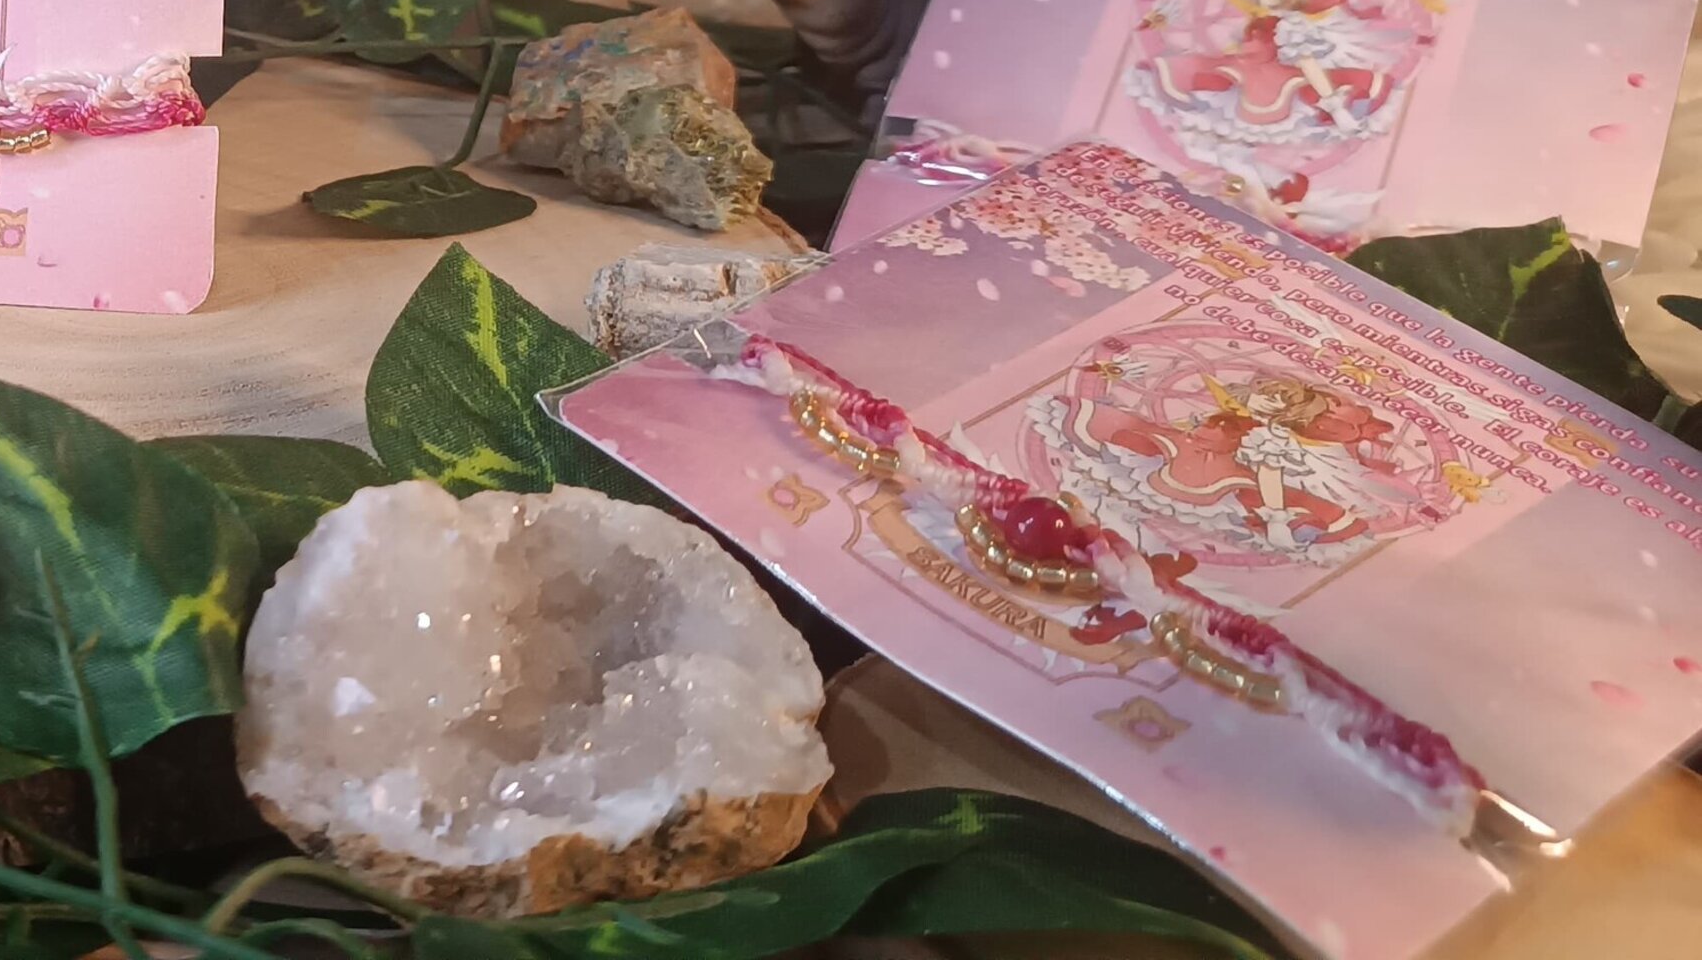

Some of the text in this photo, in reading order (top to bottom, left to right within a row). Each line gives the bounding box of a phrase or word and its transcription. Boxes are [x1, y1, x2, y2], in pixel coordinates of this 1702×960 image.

[1055, 166, 1085, 184] de
[1086, 183, 1169, 228] seguir
[1169, 225, 1282, 292] viviendo,
[1283, 288, 1353, 325] pero
[1352, 323, 1487, 395] mientras
[1486, 393, 1569, 438] sigas
[1079, 149, 1700, 480] En ocasiones es posible que la gente pierda su
[1132, 237, 1257, 302] cualquier
[1255, 301, 1320, 338] cosa
[1321, 336, 1355, 356] es
[1354, 355, 1470, 420] posible.
[1483, 417, 1522, 442] El
[1519, 440, 1621, 496] coraje
[1623, 496, 1661, 518] es
[1165, 284, 1552, 494] no debe desaparecer nunca.
[907, 546, 1047, 640] SAKURA
